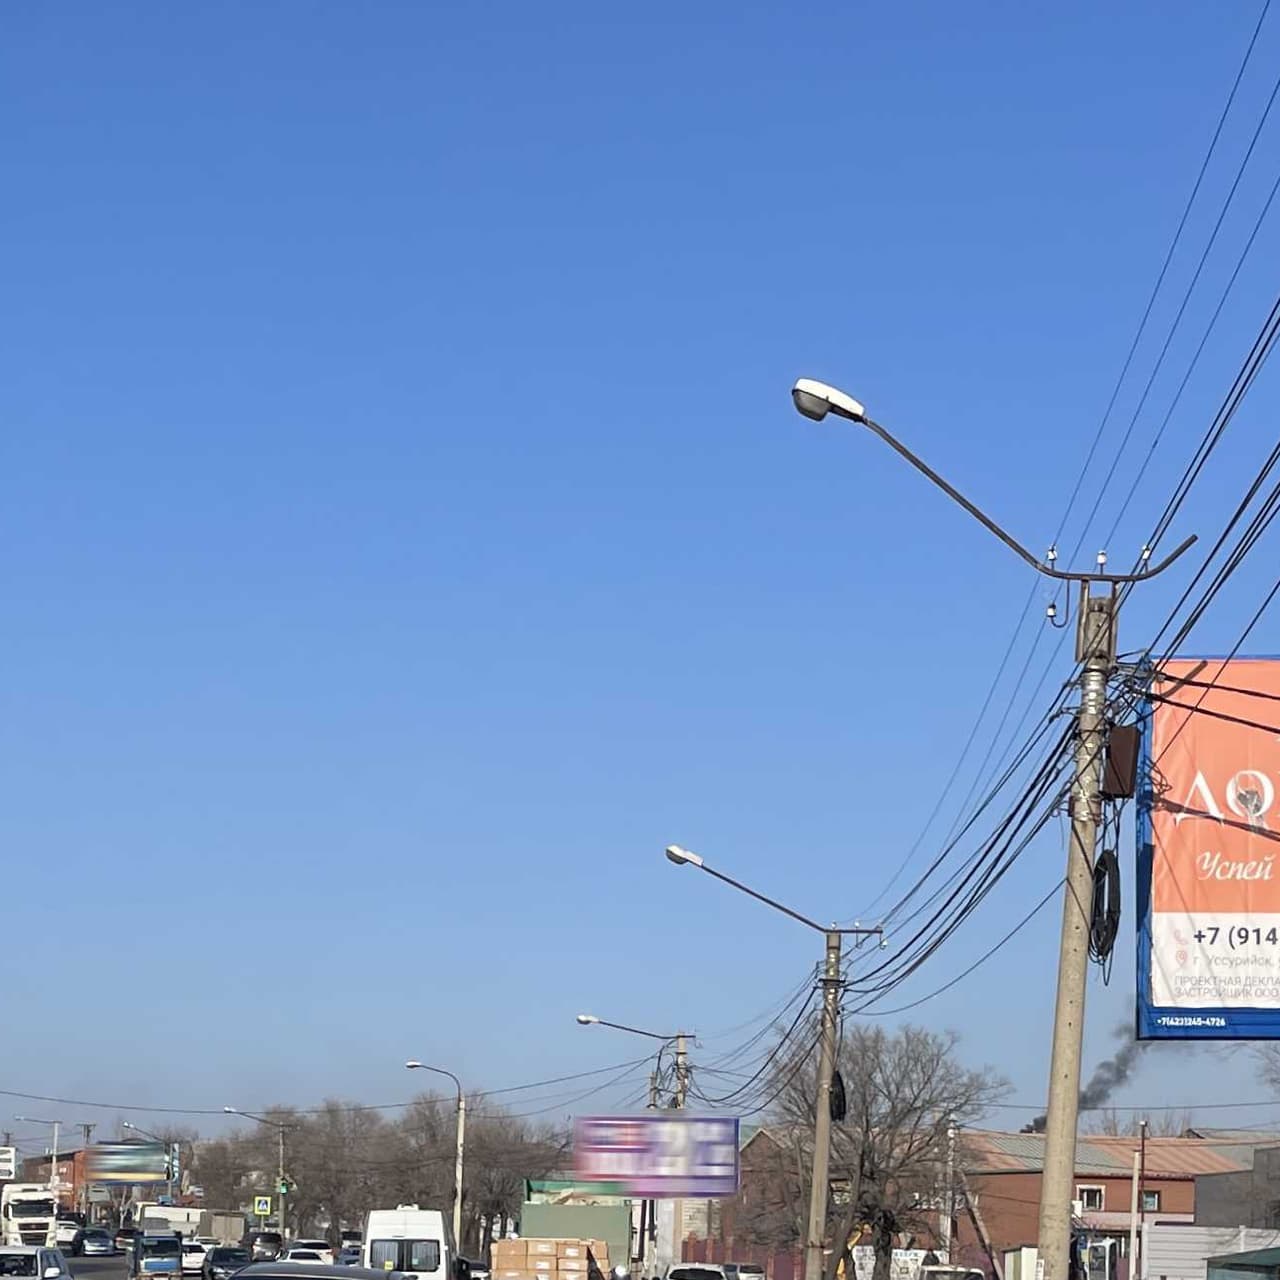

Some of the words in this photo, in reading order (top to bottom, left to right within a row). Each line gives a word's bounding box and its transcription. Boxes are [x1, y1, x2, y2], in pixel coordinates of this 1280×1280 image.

[1197, 851, 1276, 882] Успей
[1193, 927, 1220, 946] +7
[1175, 976, 1241, 986] ПРОЕКТНАЯ
